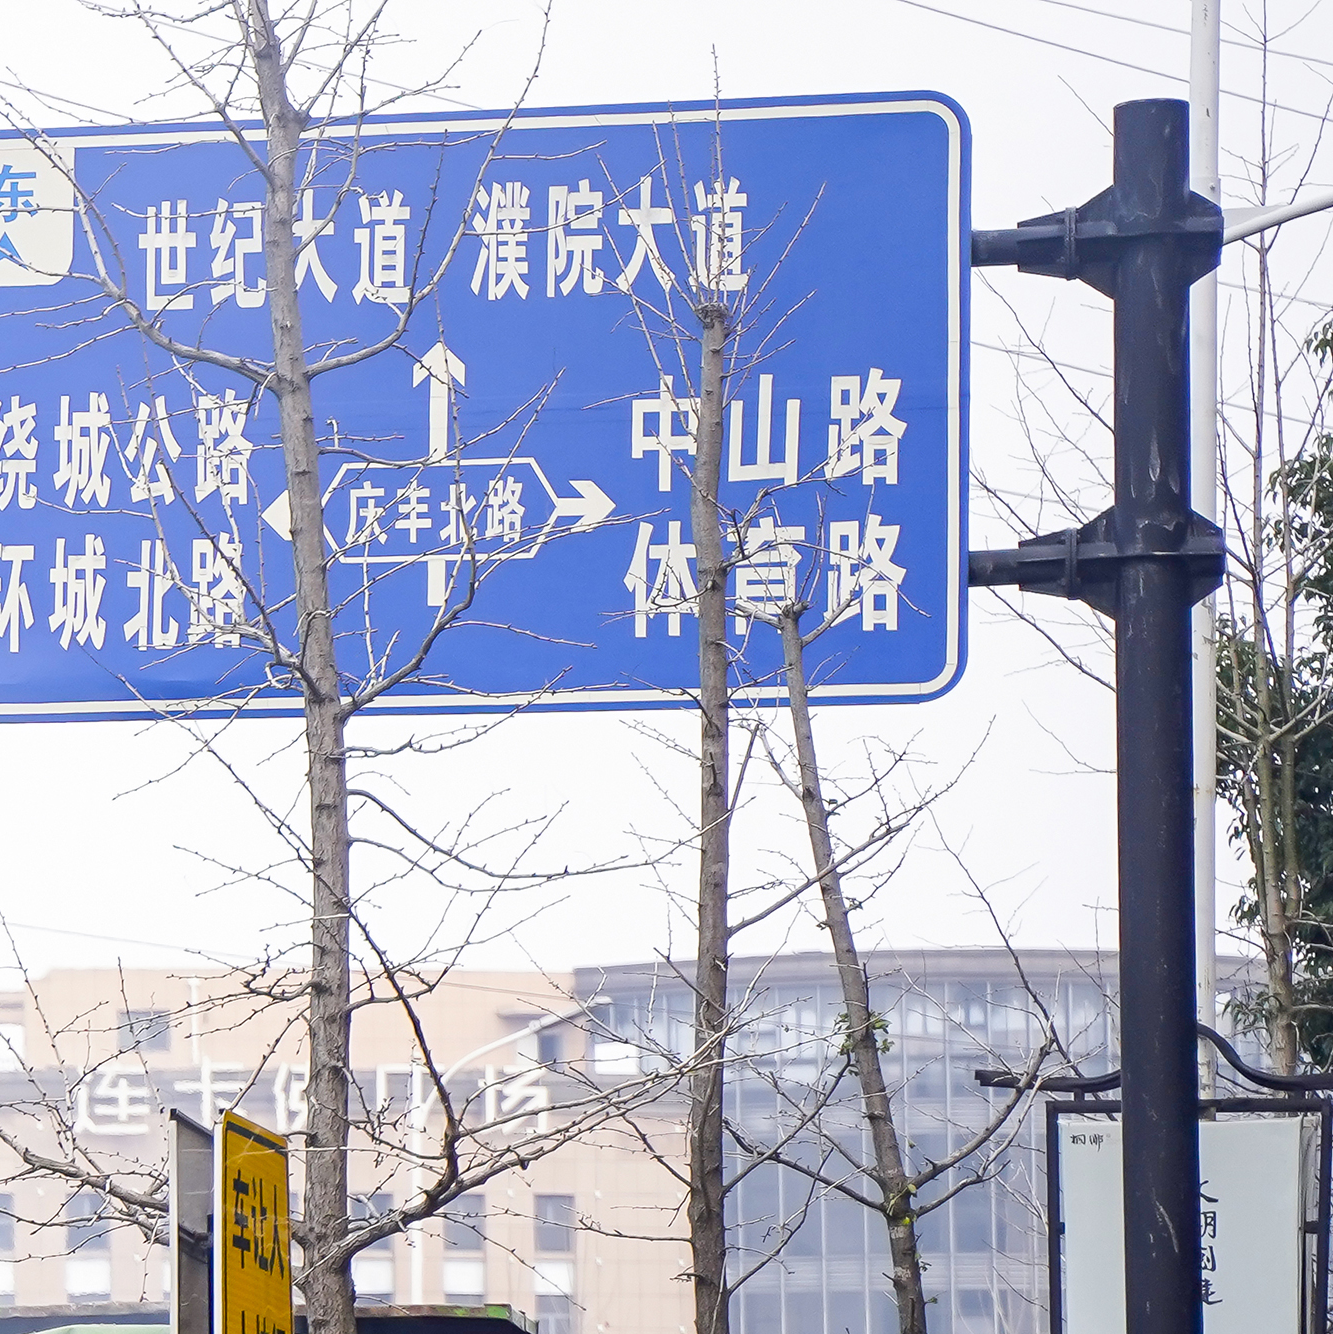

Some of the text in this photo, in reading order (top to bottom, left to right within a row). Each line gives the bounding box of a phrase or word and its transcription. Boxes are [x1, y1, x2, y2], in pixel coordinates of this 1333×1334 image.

[138, 176, 748, 310] 世纪大道 濮院大道
[631, 367, 908, 492] 中山路
[345, 476, 526, 545] 庆丰北路
[623, 514, 908, 637] 体育路
[233, 1169, 285, 1280] 车让人
